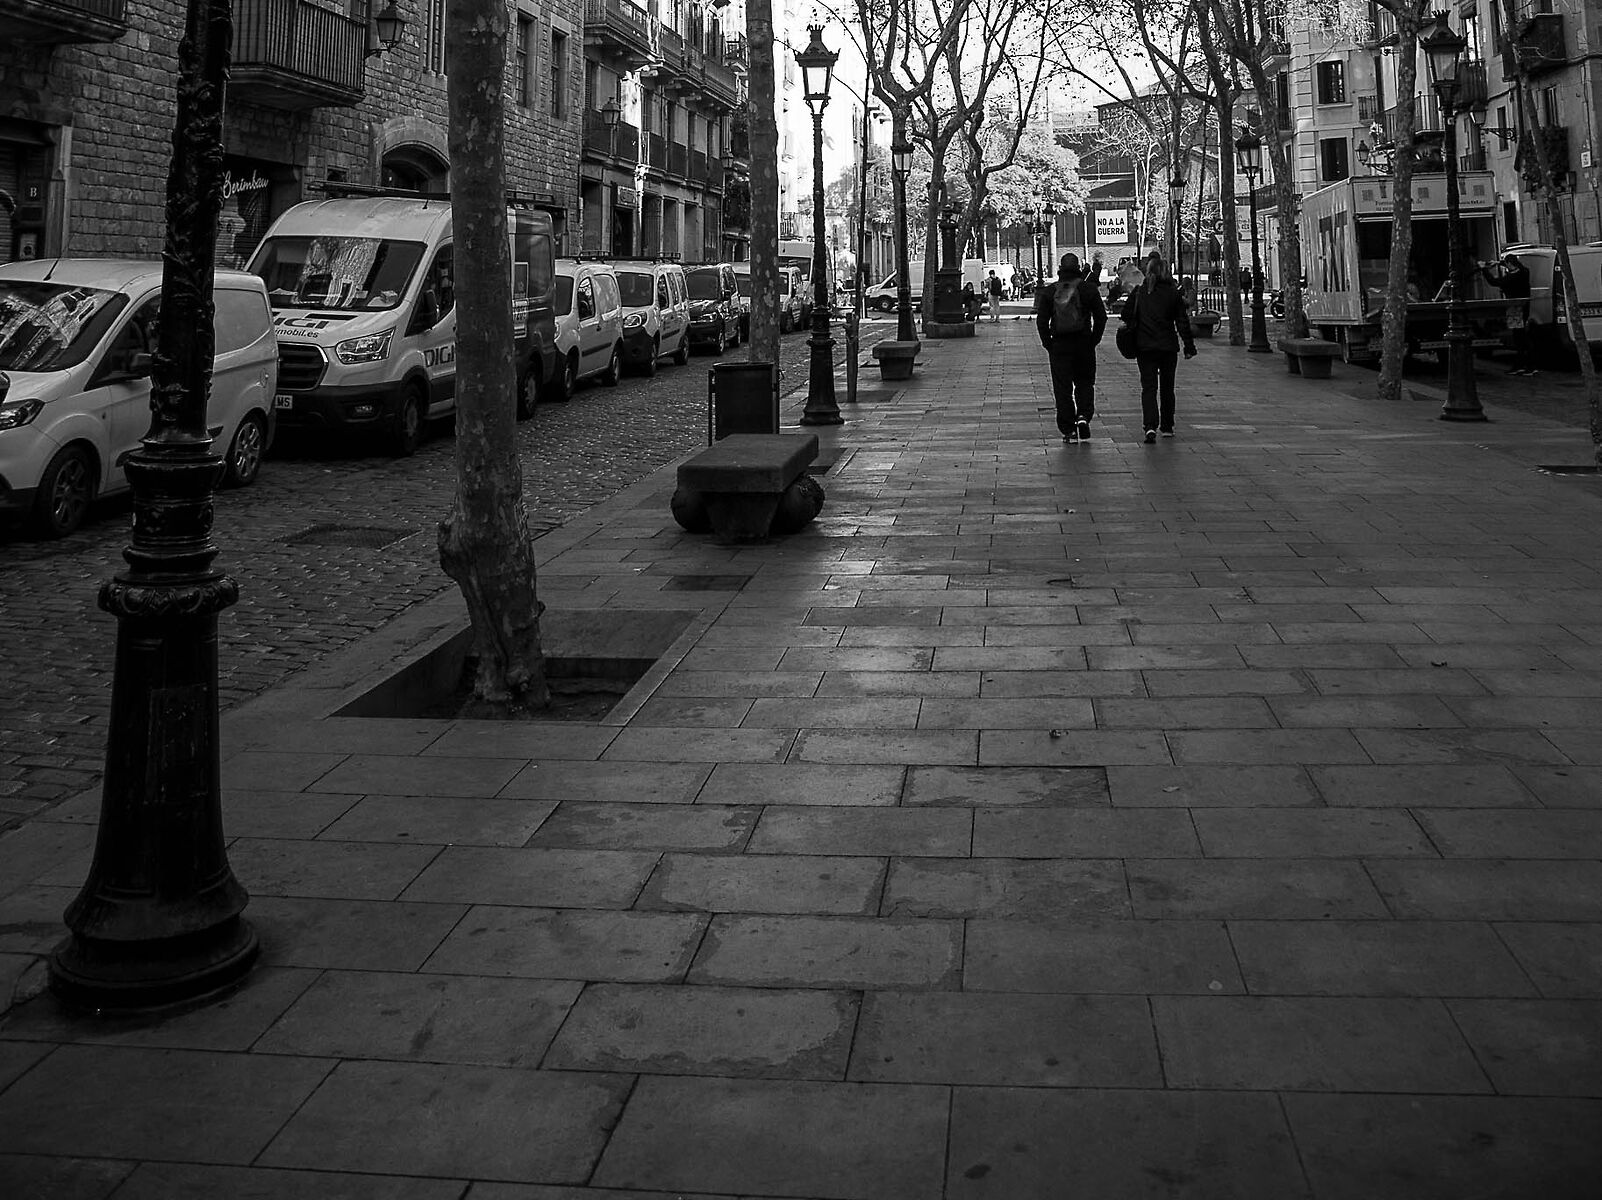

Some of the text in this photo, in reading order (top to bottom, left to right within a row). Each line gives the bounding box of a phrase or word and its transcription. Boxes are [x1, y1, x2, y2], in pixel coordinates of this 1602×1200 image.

[222, 169, 269, 199] Berimbau
[1097, 217, 1125, 226] NO A LA
[1097, 227, 1125, 236] GUERRA
[273, 317, 330, 329] IGI
[275, 329, 319, 338] mobil.es
[424, 345, 454, 368] DIGI
